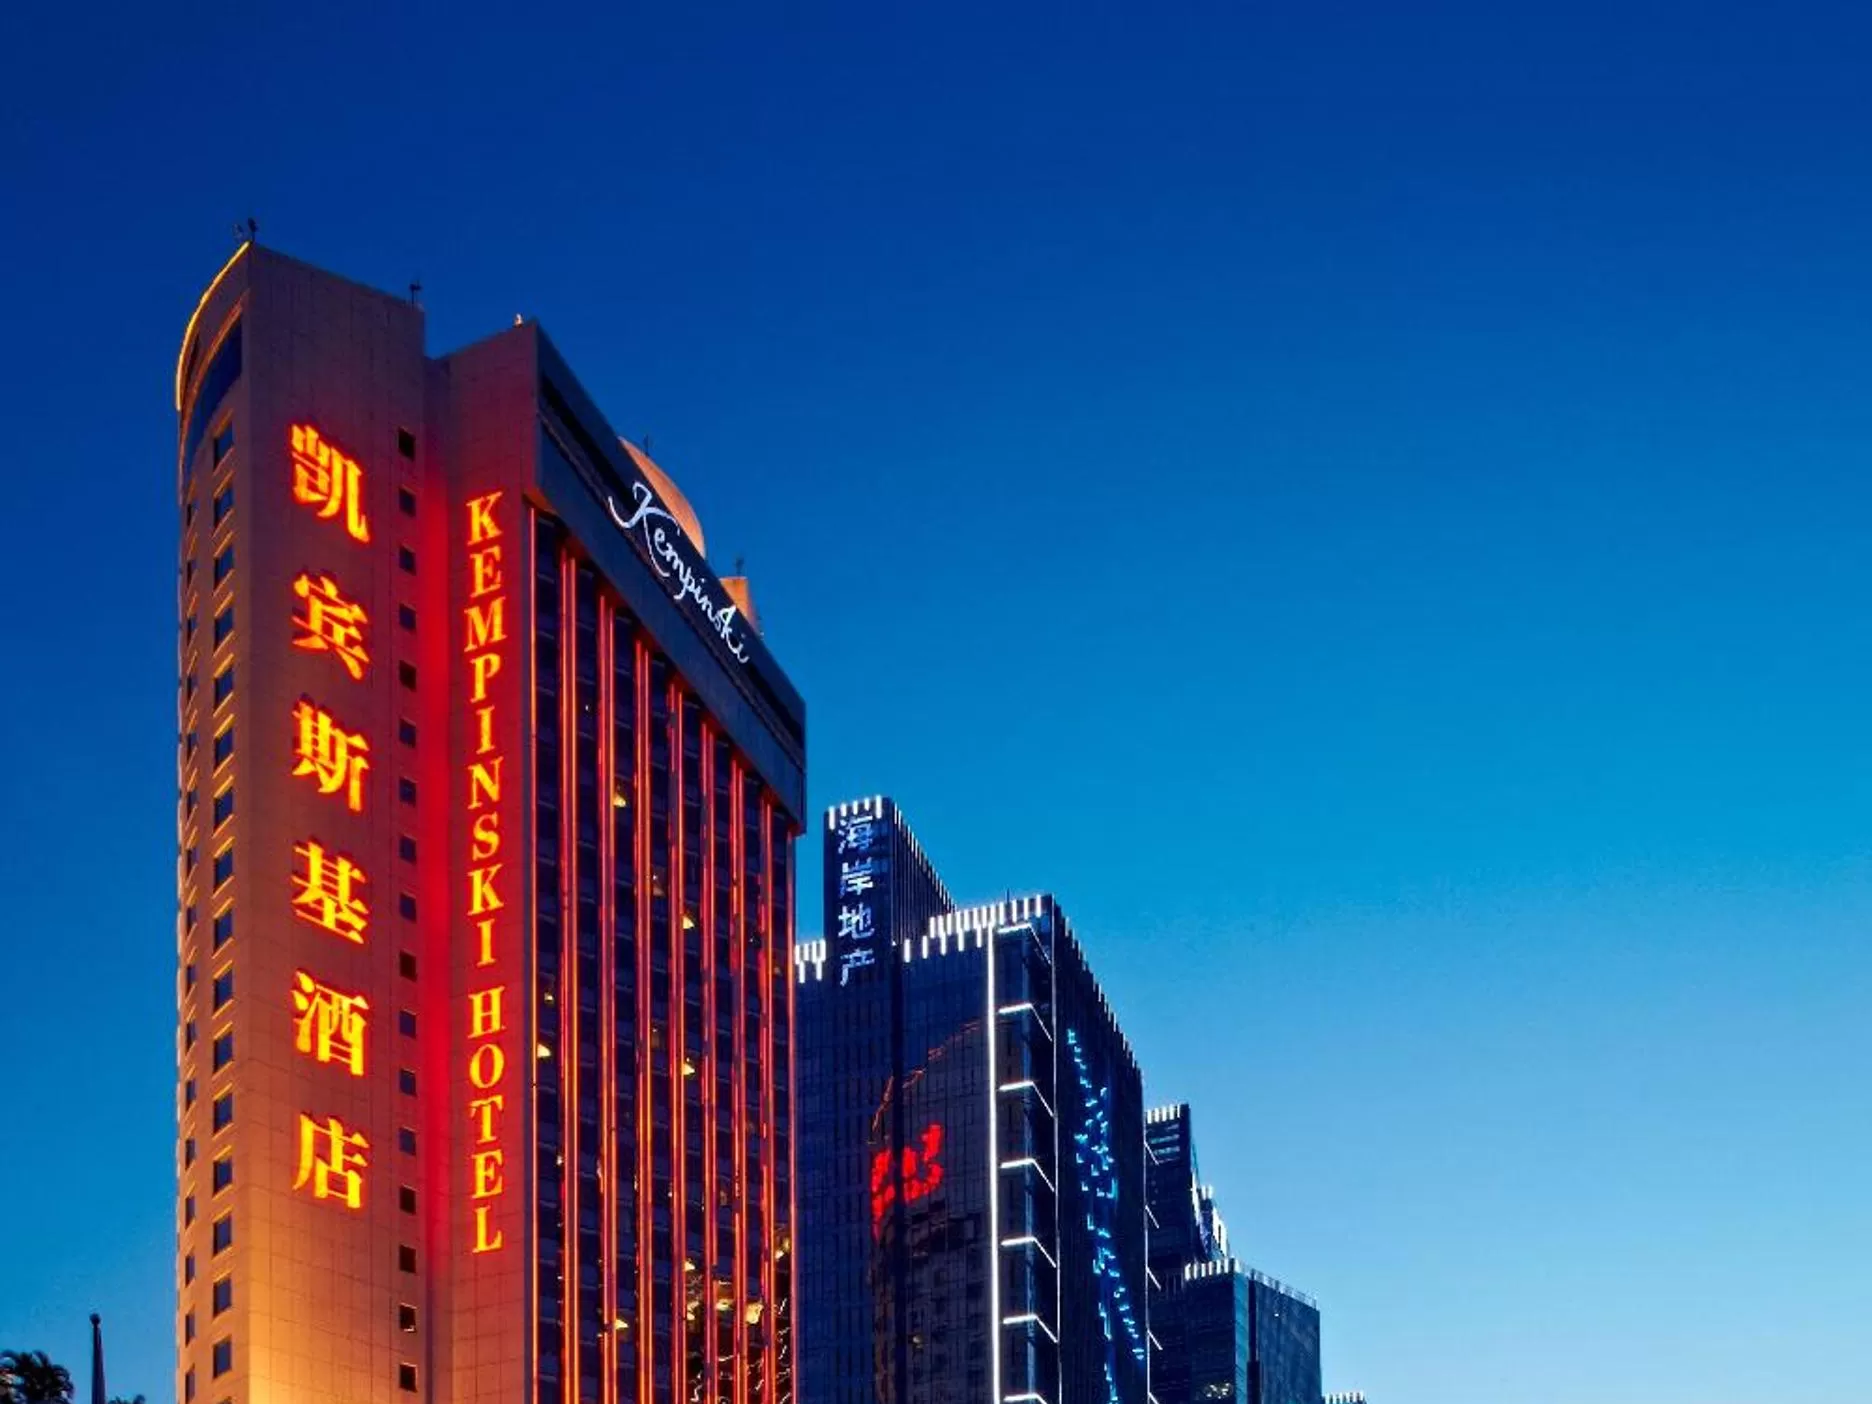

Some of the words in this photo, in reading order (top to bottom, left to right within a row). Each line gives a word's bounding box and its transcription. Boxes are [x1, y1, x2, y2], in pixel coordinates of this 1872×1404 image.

[608, 481, 750, 664] Kempinski
[290, 424, 371, 1211] 凯宾斯基酒店
[463, 491, 508, 968] KEMPINSKI
[838, 814, 876, 987] 海岸地产
[467, 985, 506, 1255] HOTEL
